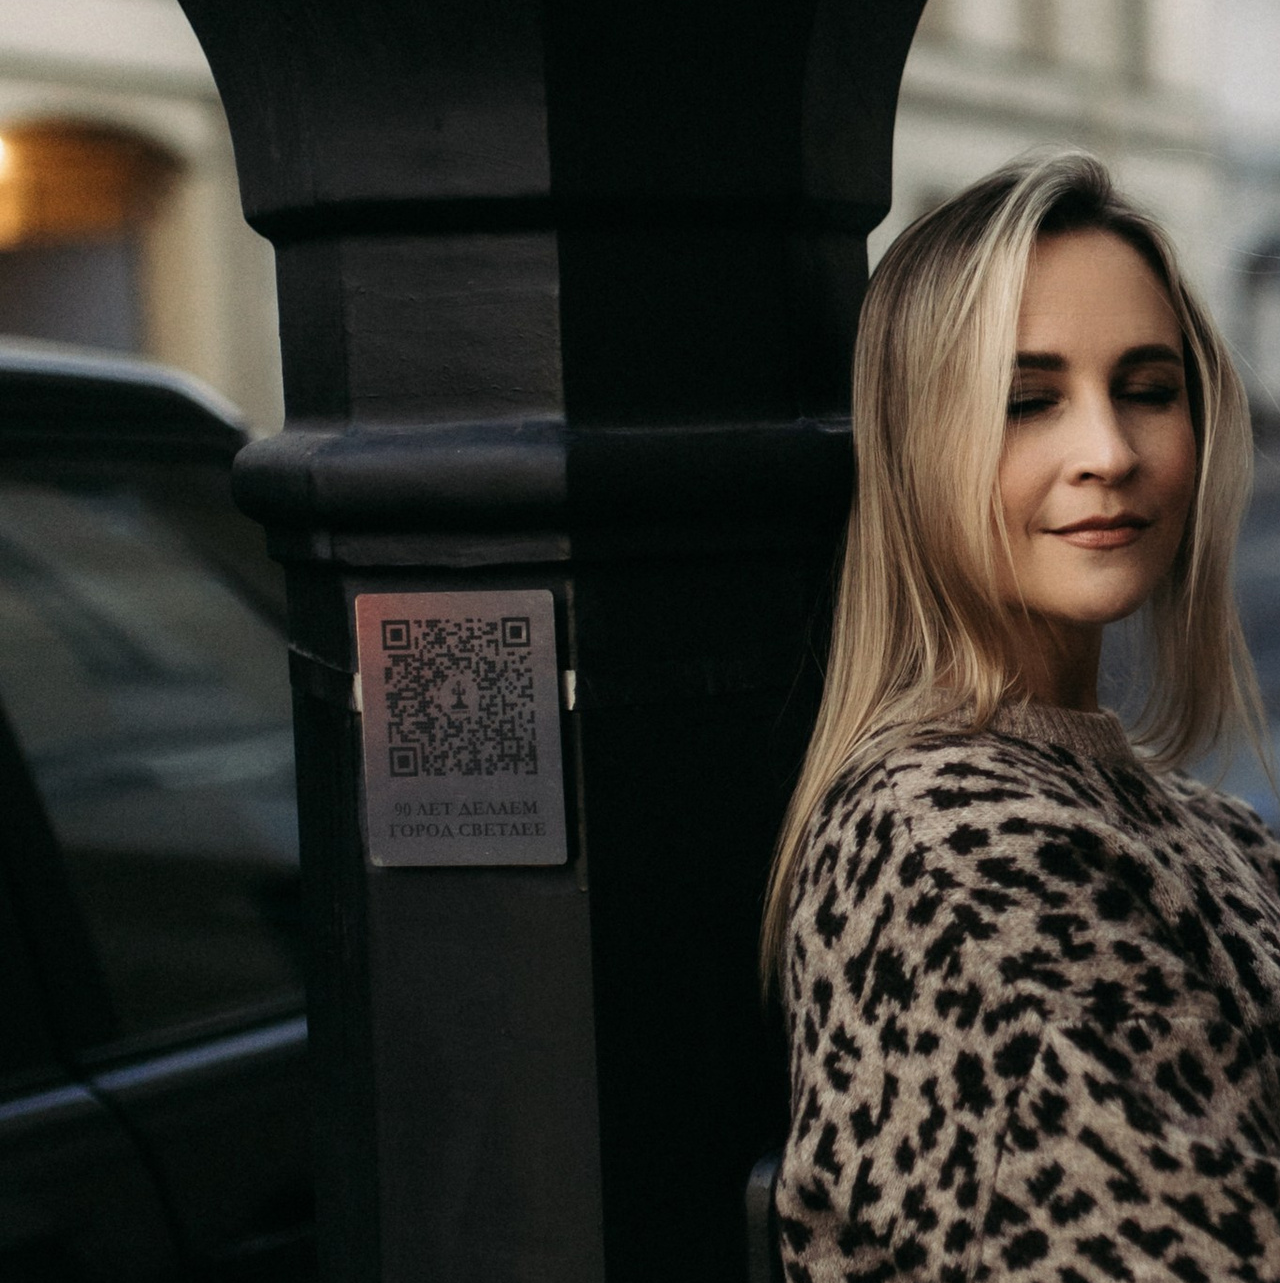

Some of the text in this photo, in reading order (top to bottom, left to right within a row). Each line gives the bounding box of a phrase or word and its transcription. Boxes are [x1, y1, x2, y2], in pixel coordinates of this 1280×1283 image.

[394, 800, 538, 818] 90 ЛЕТ ДЕЛАЕМ
[389, 822, 546, 839] ГОРОД СВЕТЛЕЕ
